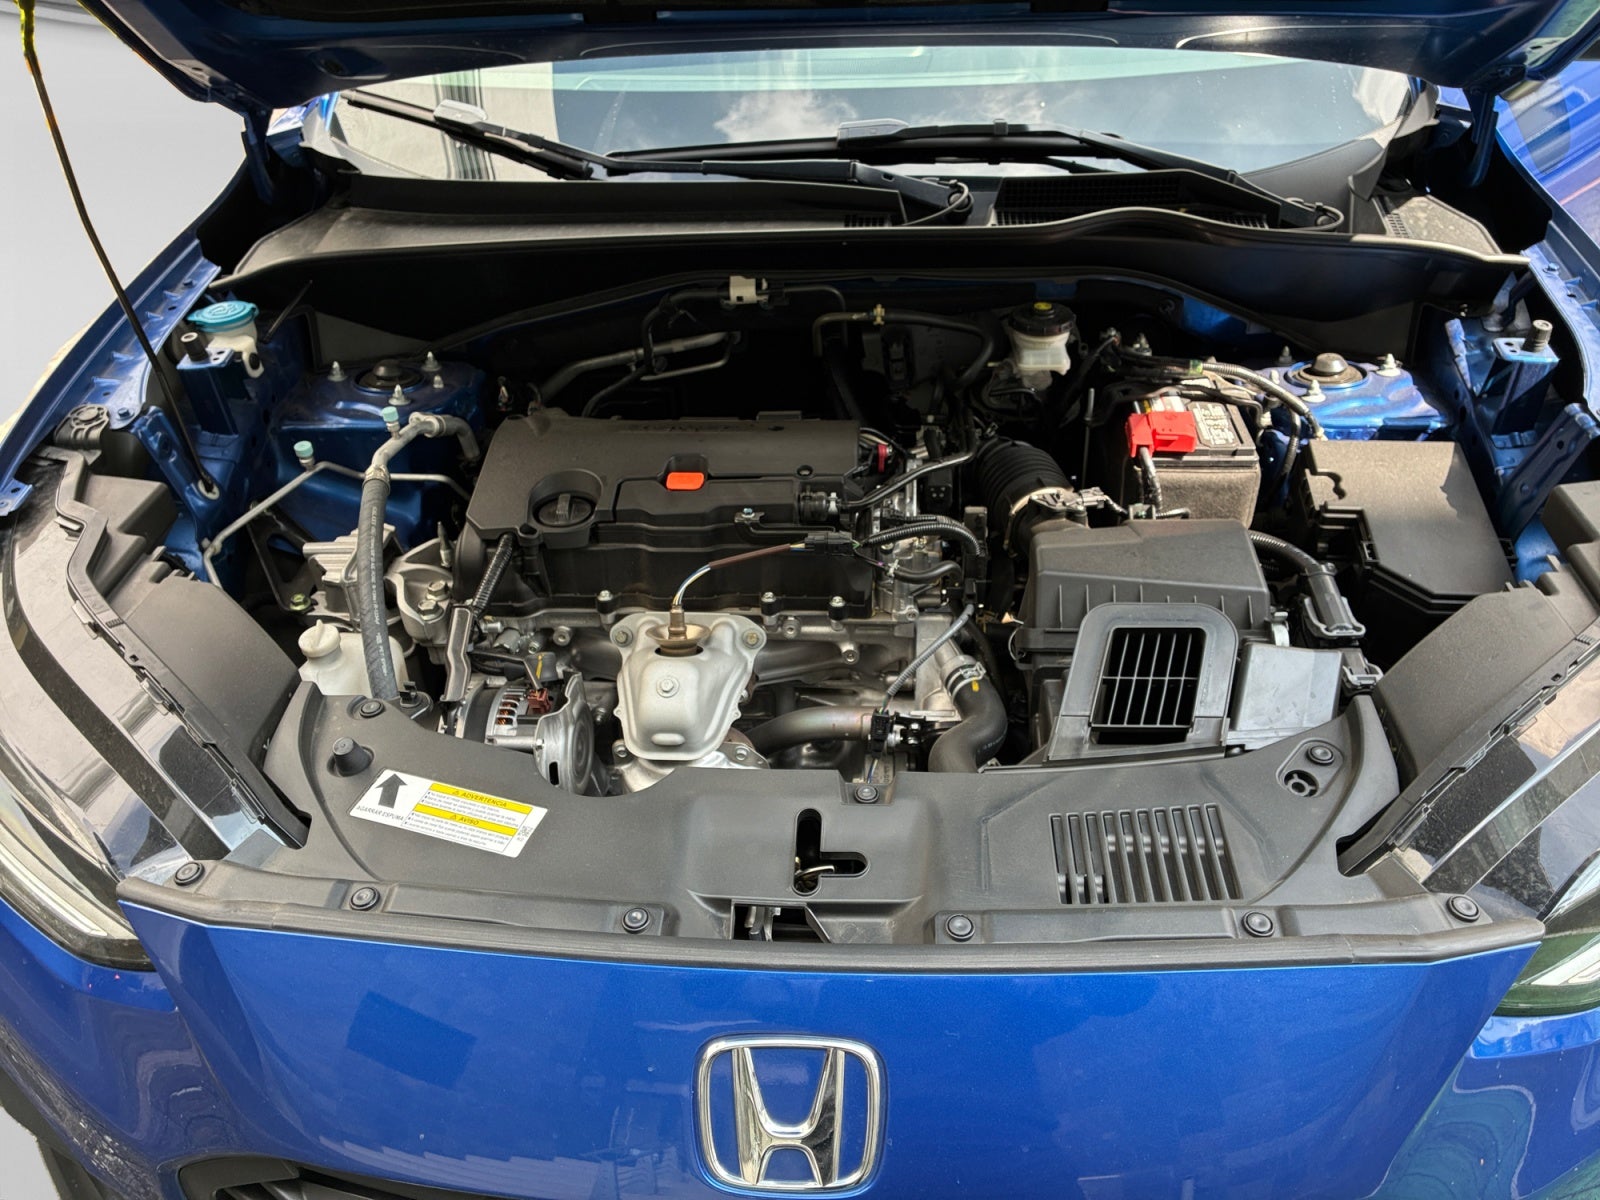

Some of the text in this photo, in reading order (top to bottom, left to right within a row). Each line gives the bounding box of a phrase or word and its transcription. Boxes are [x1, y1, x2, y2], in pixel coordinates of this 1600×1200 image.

[461, 792, 507, 808] ADVERTENCIA
[356, 805, 404, 821] AGARRAR ESPUMA
[459, 817, 480, 826] AVISO
